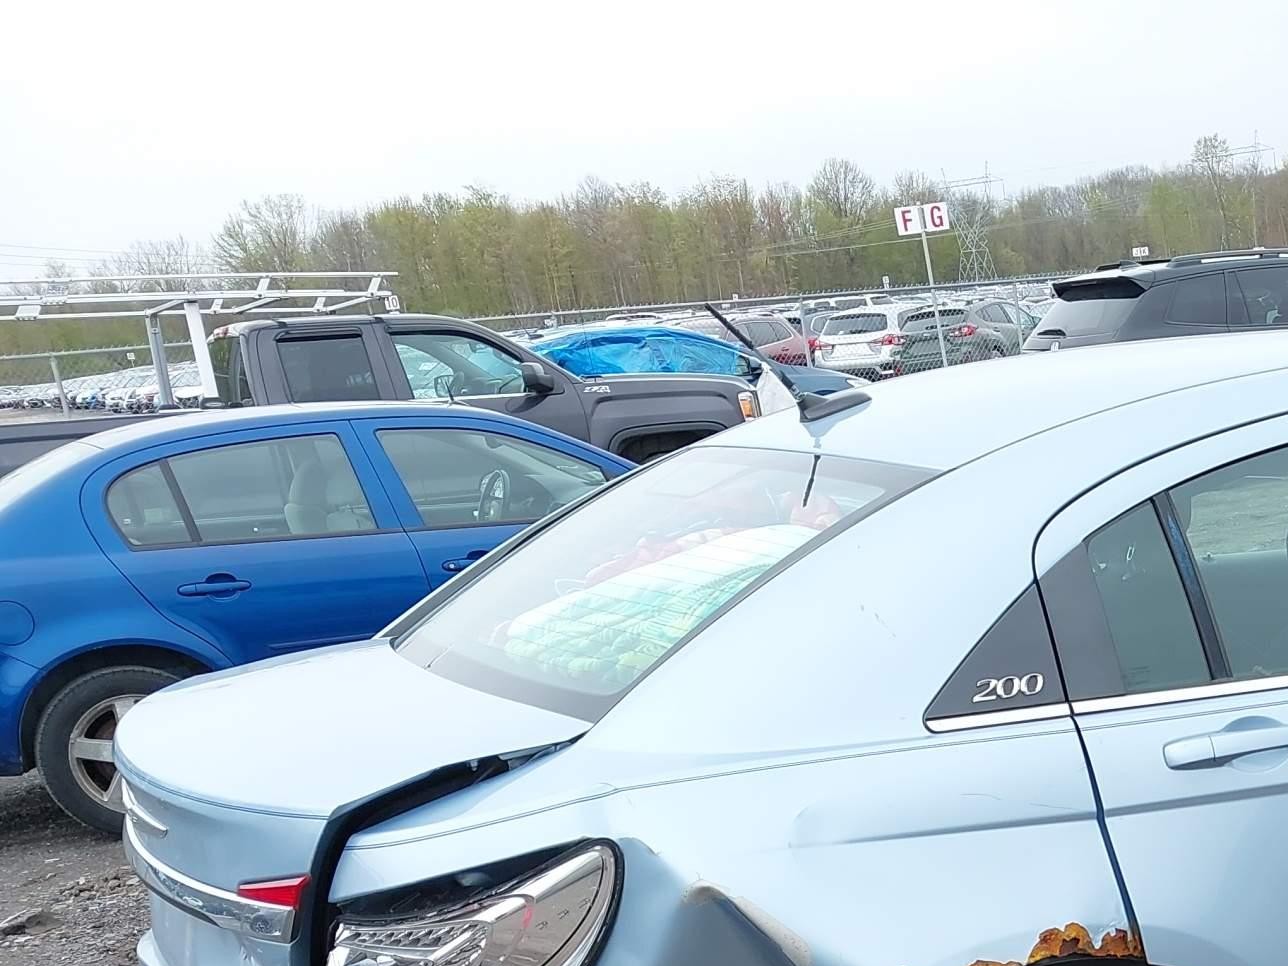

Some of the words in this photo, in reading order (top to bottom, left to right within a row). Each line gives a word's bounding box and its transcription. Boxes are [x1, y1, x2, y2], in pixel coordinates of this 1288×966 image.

[901, 210, 912, 232] F
[930, 205, 944, 228] G
[972, 672, 1044, 703] 200
